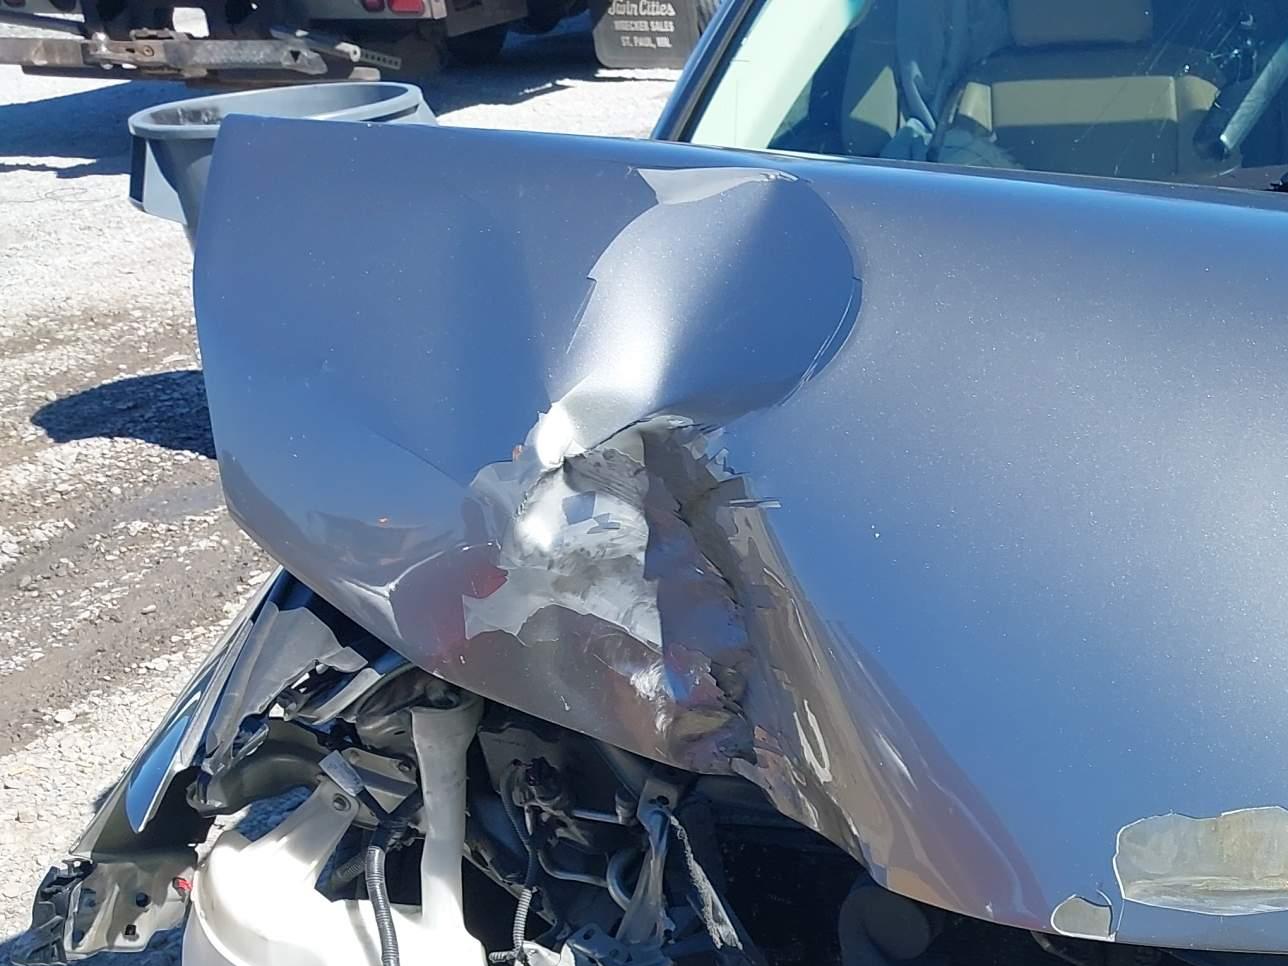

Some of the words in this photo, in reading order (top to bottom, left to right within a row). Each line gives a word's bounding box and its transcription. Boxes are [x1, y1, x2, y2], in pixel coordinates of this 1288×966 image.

[608, 0, 638, 16] Twin
[639, 0, 676, 16] Cities
[650, 20, 675, 32] SALES
